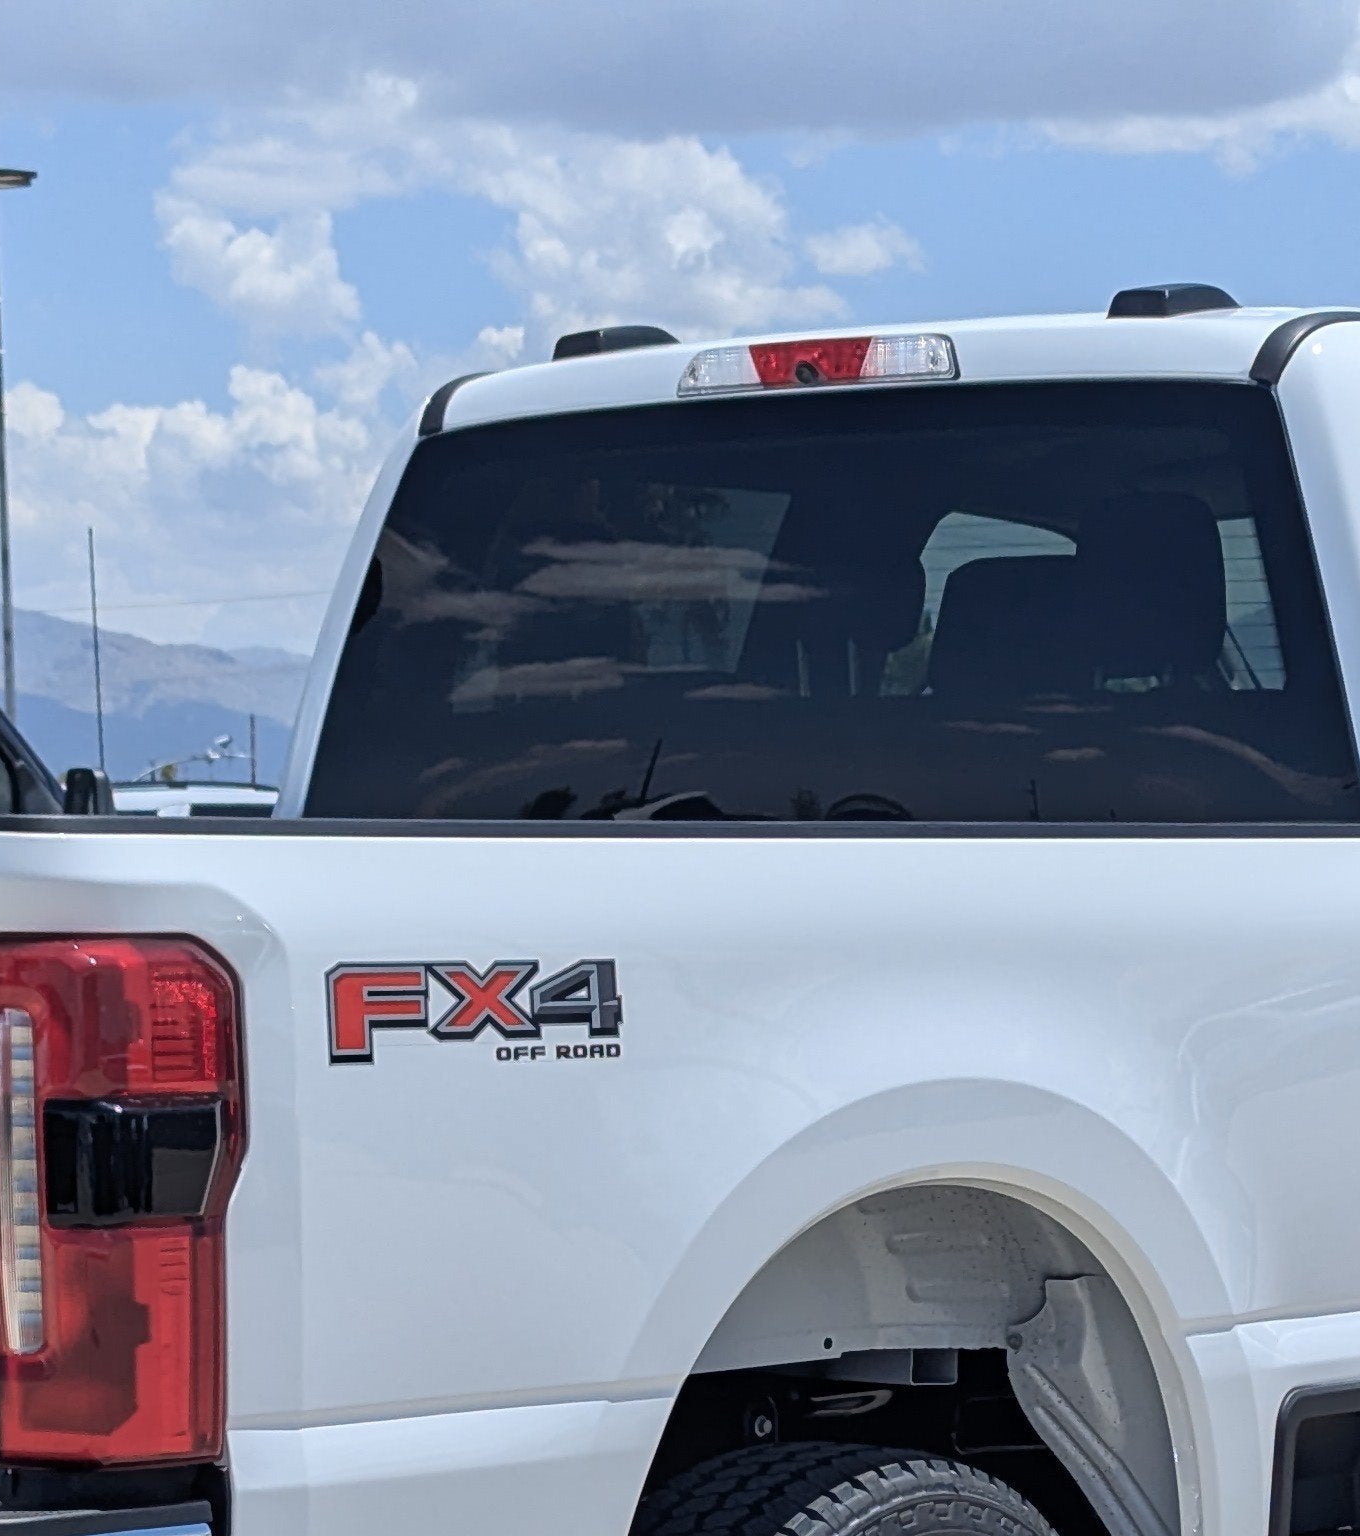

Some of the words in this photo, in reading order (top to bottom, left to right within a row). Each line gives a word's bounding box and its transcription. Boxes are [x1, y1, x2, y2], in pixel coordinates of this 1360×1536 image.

[325, 959, 624, 1067] FX4
[495, 1044, 546, 1062] OFF
[555, 1042, 622, 1060] ROAD
